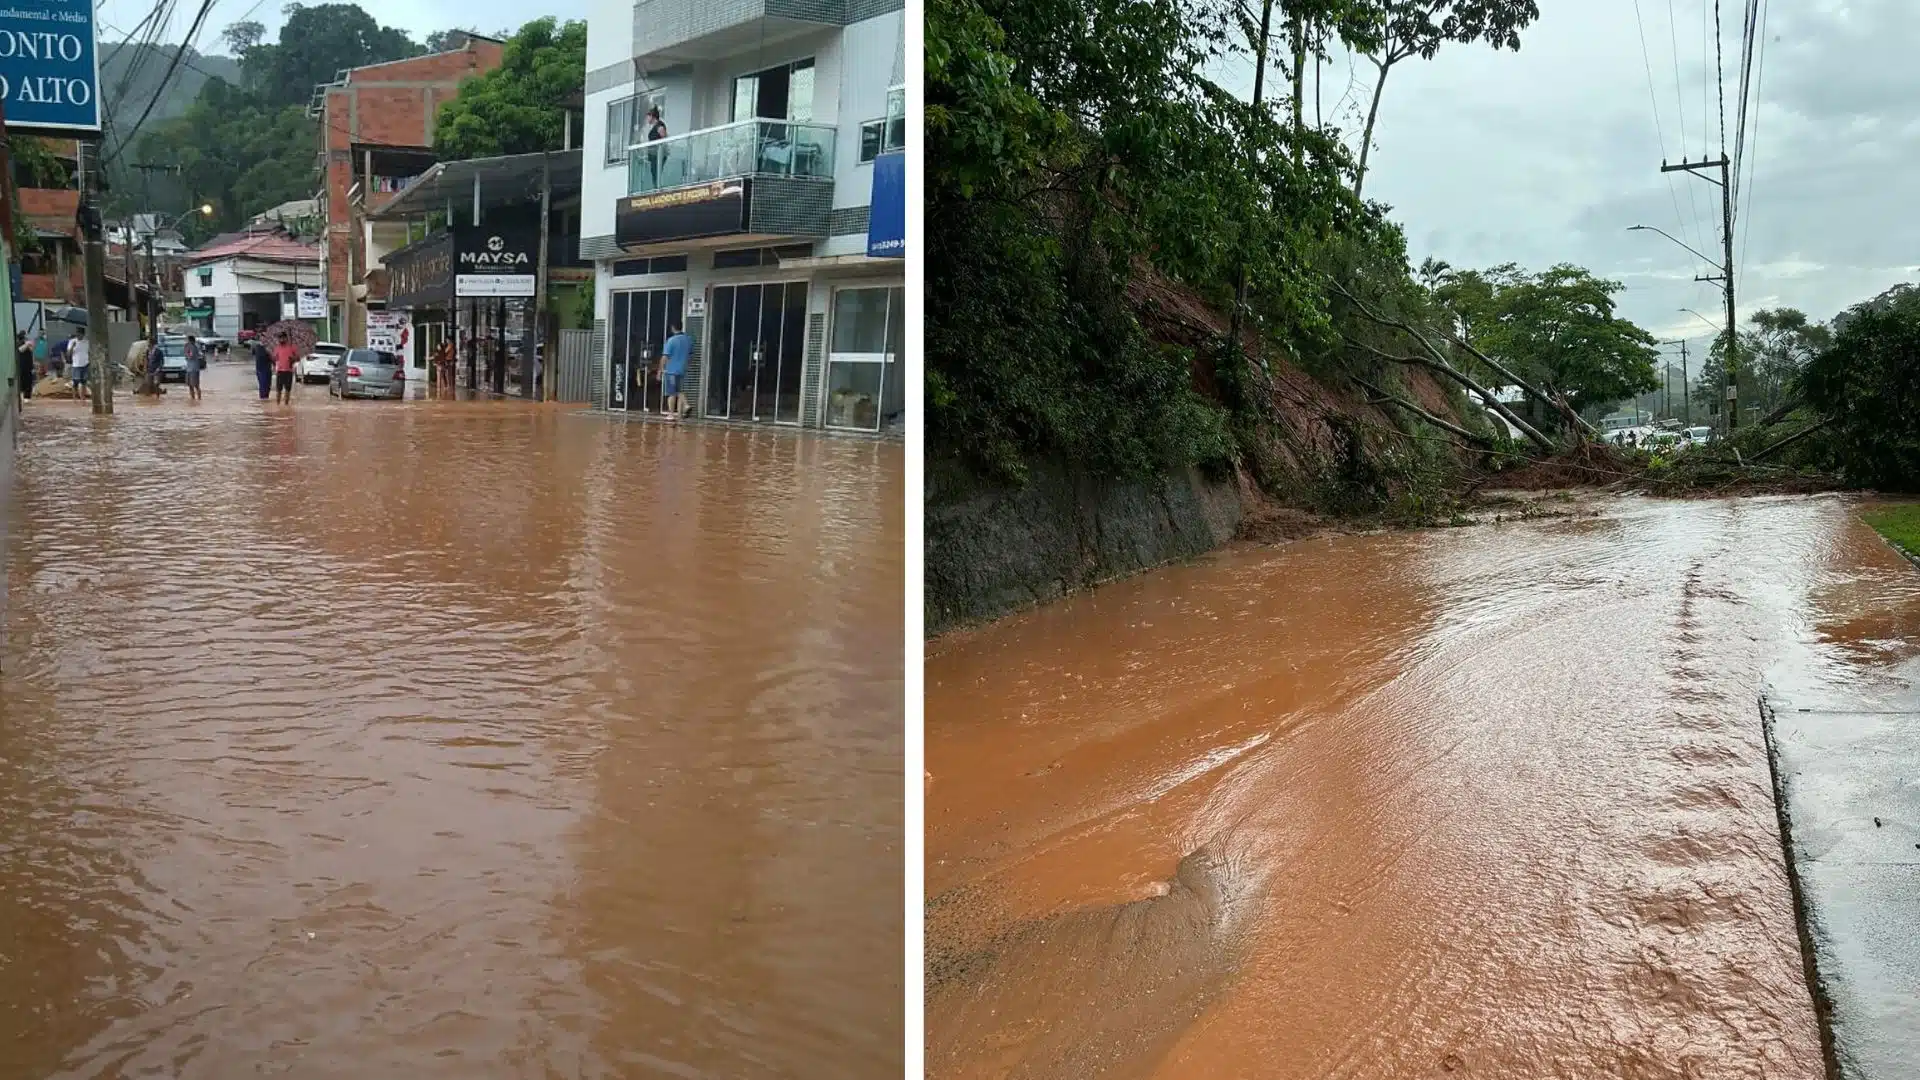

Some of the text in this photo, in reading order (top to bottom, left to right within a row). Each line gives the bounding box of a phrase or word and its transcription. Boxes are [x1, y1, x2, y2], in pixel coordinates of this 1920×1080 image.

[51, 13, 58, 21] e
[0, 29, 82, 61] ONTO
[16, 76, 90, 106] ALTO
[460, 252, 528, 264] MAYSA
